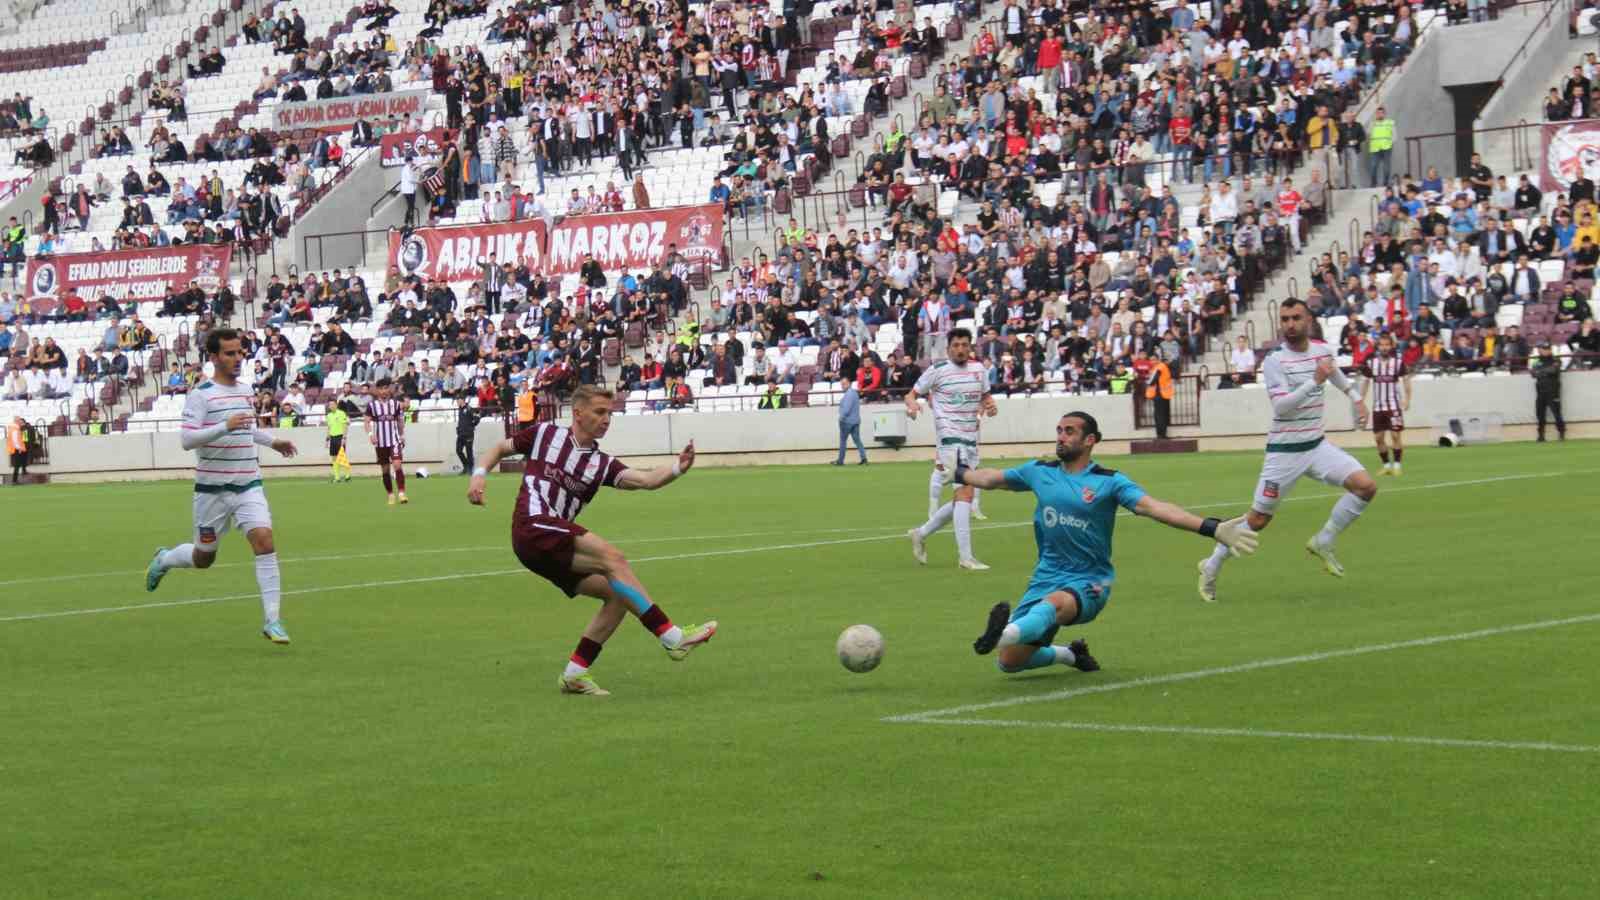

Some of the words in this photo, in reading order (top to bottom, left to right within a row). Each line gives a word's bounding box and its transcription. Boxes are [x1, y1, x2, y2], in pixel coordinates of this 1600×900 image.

[68, 263, 100, 281] EFKAR
[100, 259, 127, 278] DOLU
[127, 254, 188, 280] ŞEHİRLERDE
[435, 230, 541, 278] ABLUKA
[550, 221, 668, 270] NARKOZ
